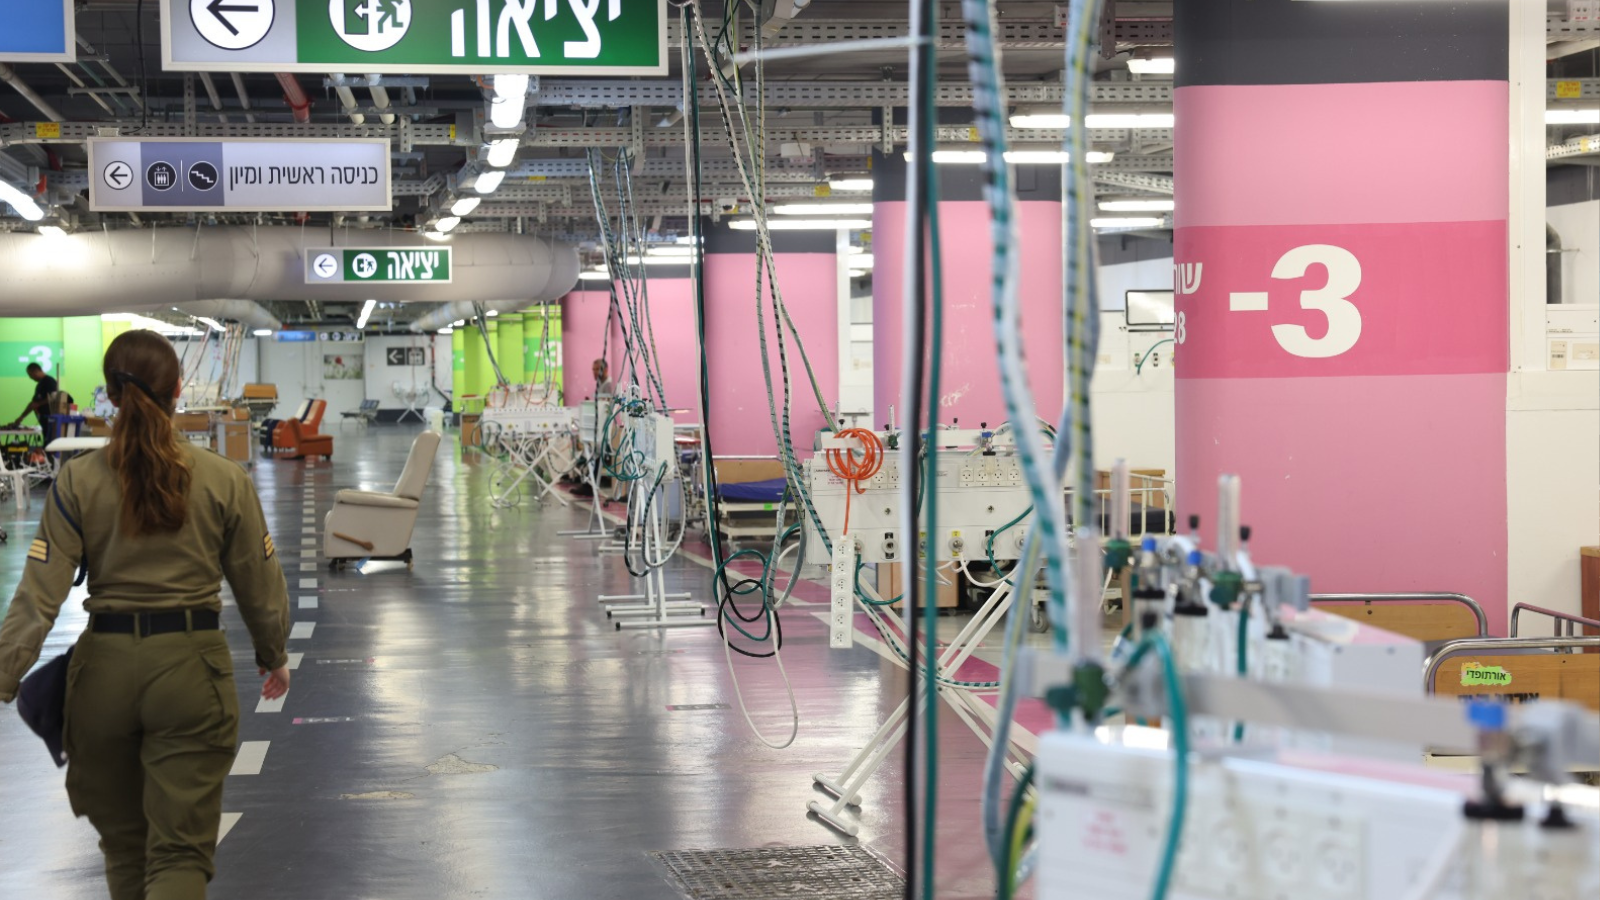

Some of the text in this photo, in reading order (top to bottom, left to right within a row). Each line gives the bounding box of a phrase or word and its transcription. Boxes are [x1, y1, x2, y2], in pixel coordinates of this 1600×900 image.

[229, 166, 379, 192] כניסה ראשית ומיון
[386, 251, 440, 280] יציאה
[1229, 243, 1362, 358] -3
[1466, 670, 1507, 681] אורתופדי
